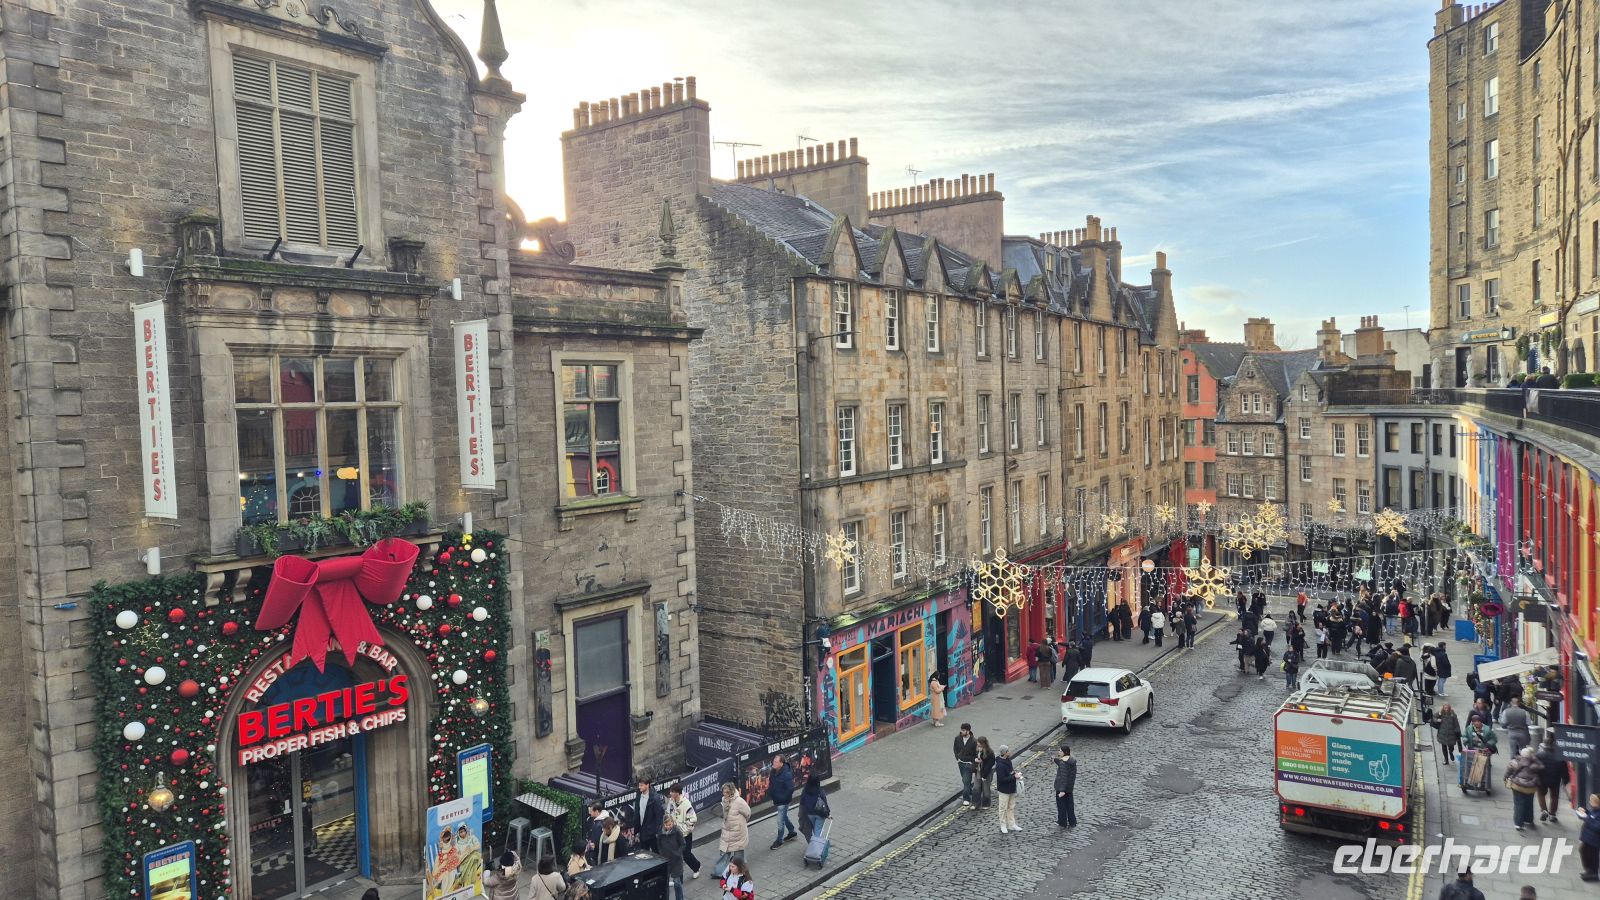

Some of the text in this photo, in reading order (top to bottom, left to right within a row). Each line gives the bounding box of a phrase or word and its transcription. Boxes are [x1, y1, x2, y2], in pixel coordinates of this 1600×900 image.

[143, 319, 162, 502] BERTIES
[463, 333, 479, 476] BERTIES
[867, 605, 925, 636] MARIACHI
[357, 641, 367, 654] &
[367, 644, 398, 672] BAR
[238, 674, 409, 746] BERTIE'S
[240, 709, 407, 766] PROPER FISH & CHIPS
[1566, 731, 1585, 739] THE
[768, 736, 800, 754] BEER GARDEN
[1332, 742, 1352, 750] Glass
[1556, 740, 1596, 750] WHISKY
[1563, 750, 1589, 758] SHOP
[1332, 751, 1364, 760] recycling
[1332, 758, 1352, 766] made
[1283, 773, 1394, 793] WWW.CHANGEWASTERECYCLING.CO.UK
[605, 797, 618, 808] FIRST
